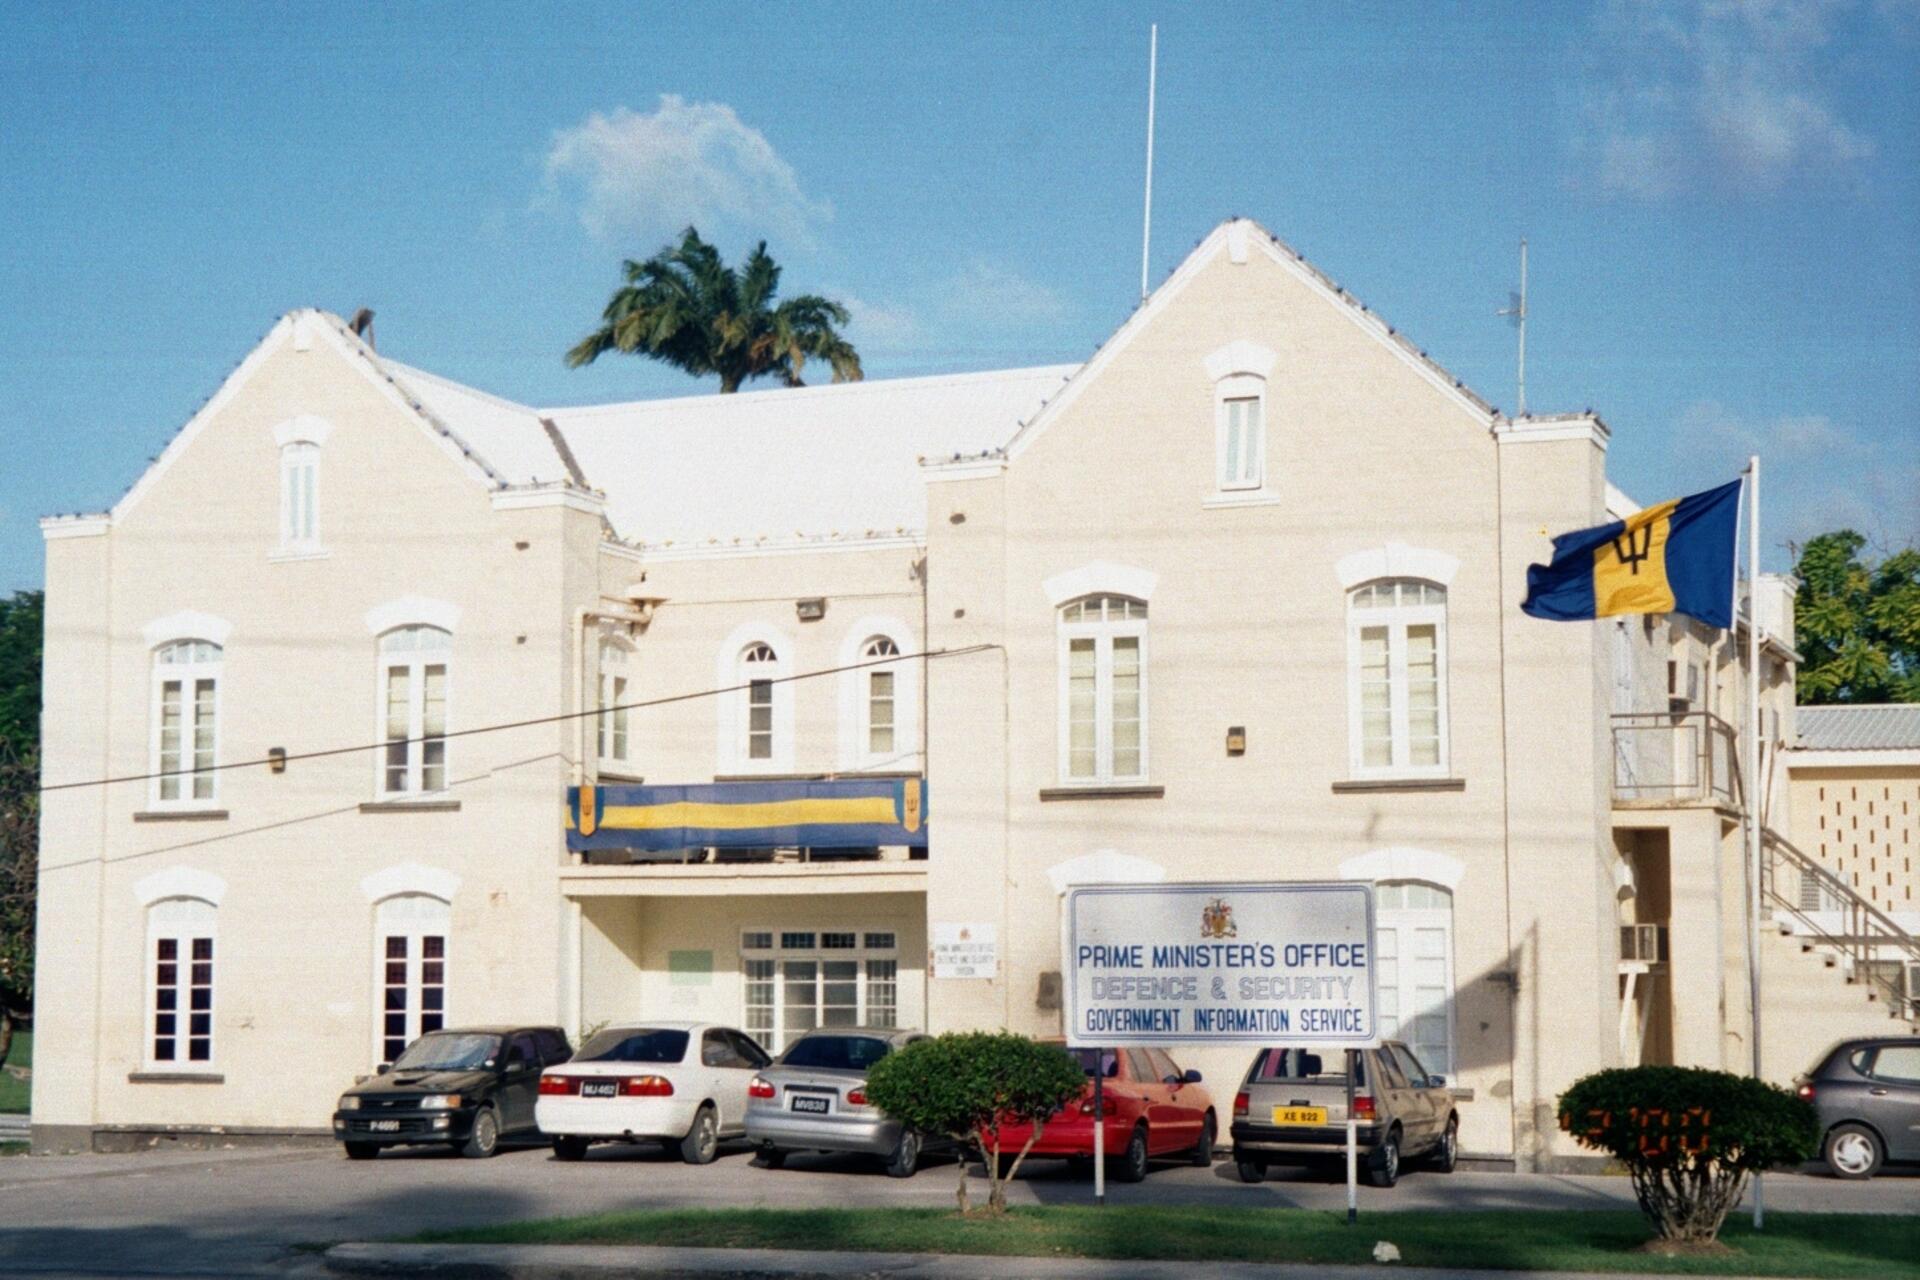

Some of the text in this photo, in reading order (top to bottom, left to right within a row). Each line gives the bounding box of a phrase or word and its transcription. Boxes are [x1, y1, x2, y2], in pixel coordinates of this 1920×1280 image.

[1079, 941, 1366, 968] PRIME MINISTER'S OFFICE
[1091, 975, 1354, 1000] DEFENCE & SECURITY
[1086, 1008, 1362, 1032] GOVERNMENT INFORMATION SERVICE
